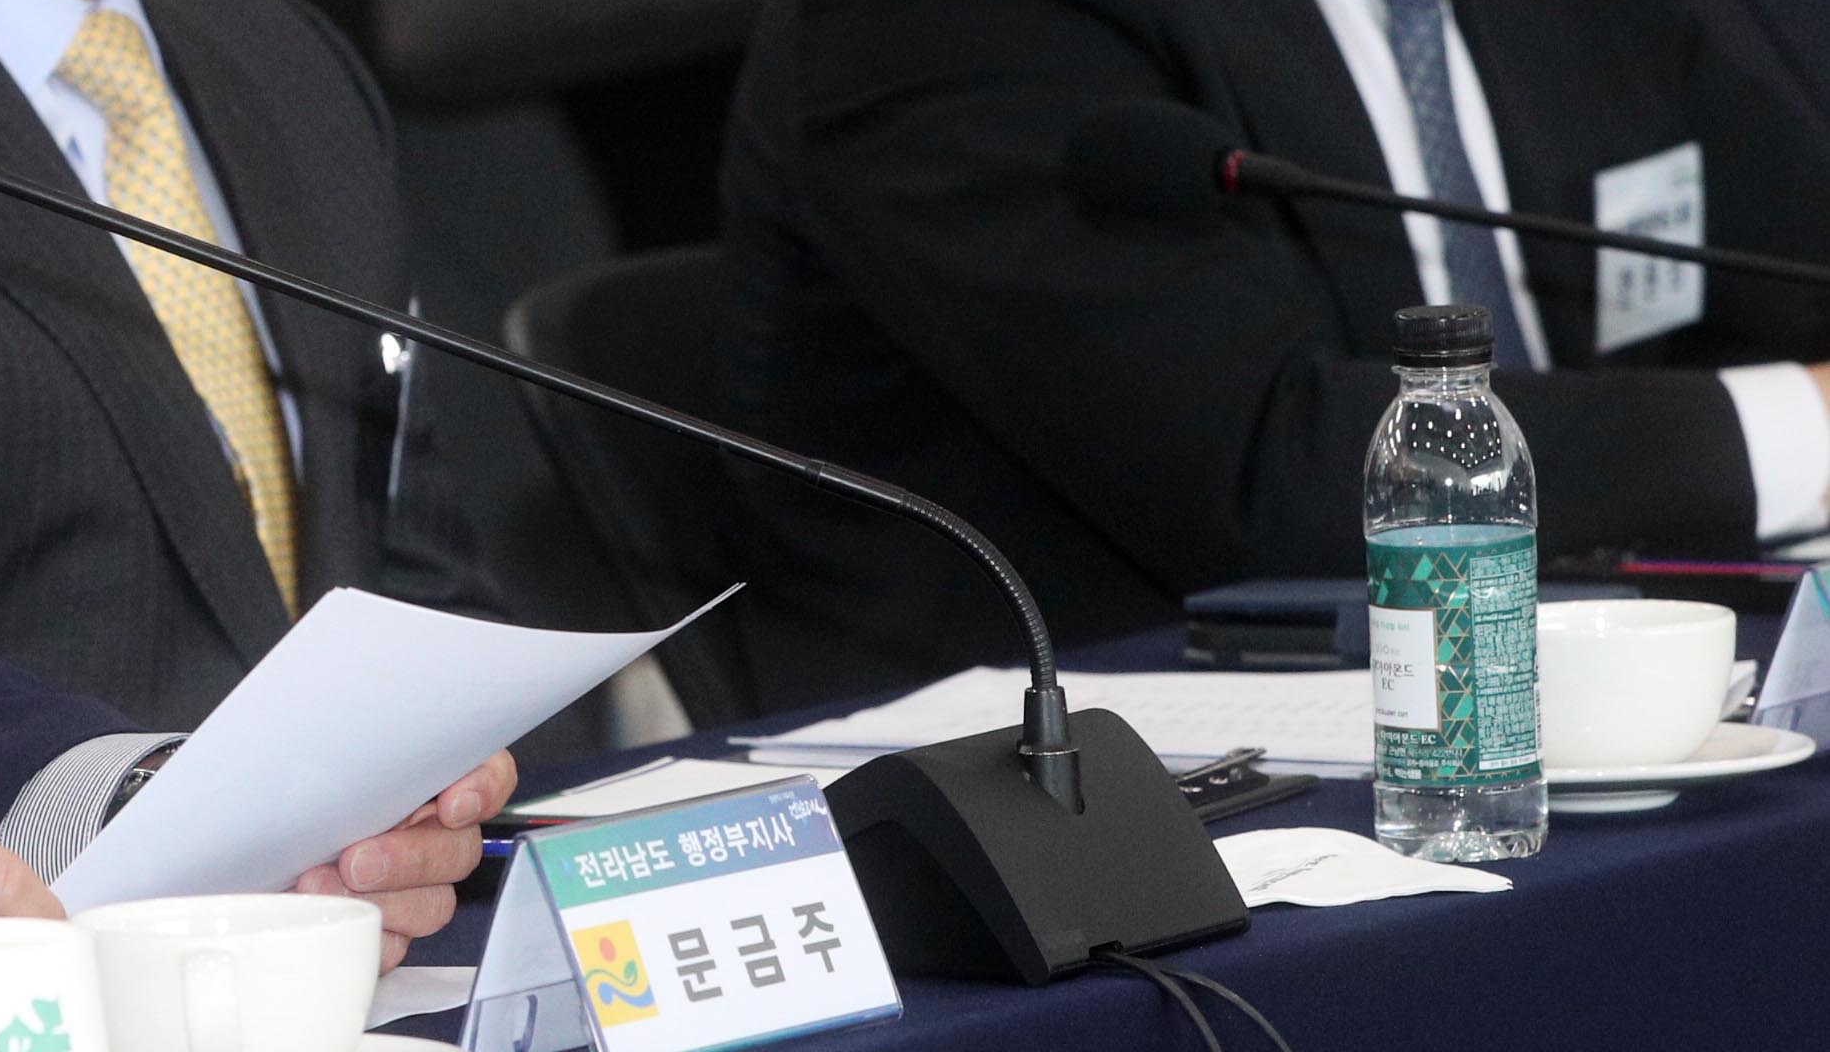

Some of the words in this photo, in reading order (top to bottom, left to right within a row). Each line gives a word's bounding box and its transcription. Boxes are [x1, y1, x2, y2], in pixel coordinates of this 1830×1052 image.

[1421, 734, 1437, 745] EC
[573, 838, 676, 890] 전라남도
[678, 811, 797, 870] 행정부지사
[667, 901, 842, 1003] 문금주
